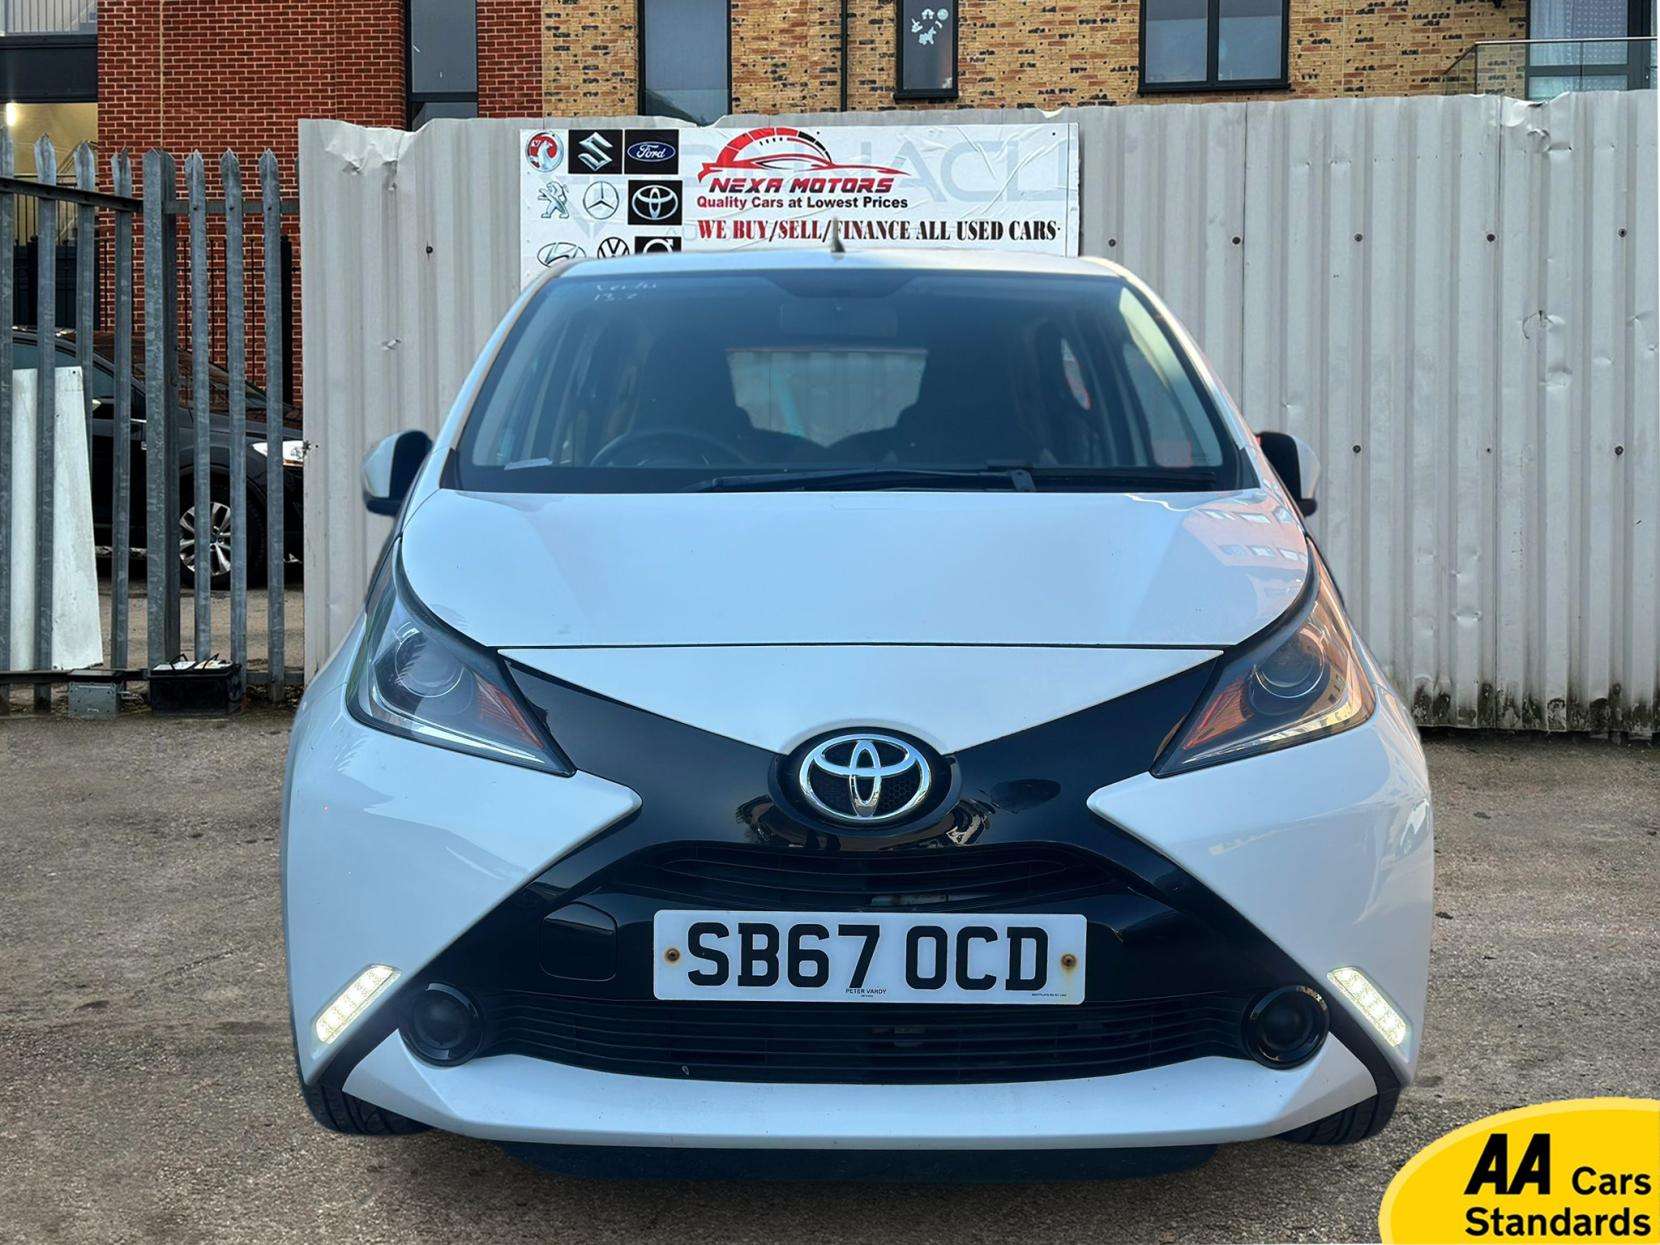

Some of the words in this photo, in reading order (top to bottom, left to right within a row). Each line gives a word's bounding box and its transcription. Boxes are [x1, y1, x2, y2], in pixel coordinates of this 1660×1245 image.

[635, 144, 666, 159] Ford
[708, 177, 784, 194] NEXA
[789, 177, 895, 194] MOTORS
[697, 195, 748, 211] Quality
[751, 196, 784, 209] Cars
[788, 196, 803, 209] at
[806, 196, 859, 209] Lowest
[863, 196, 908, 209] Prices
[697, 219, 727, 239] WE
[914, 220, 951, 241] ALL
[956, 220, 1004, 241] USED
[1008, 220, 1057, 241] CARS
[687, 921, 881, 989] SB67
[905, 925, 1049, 991] OCD
